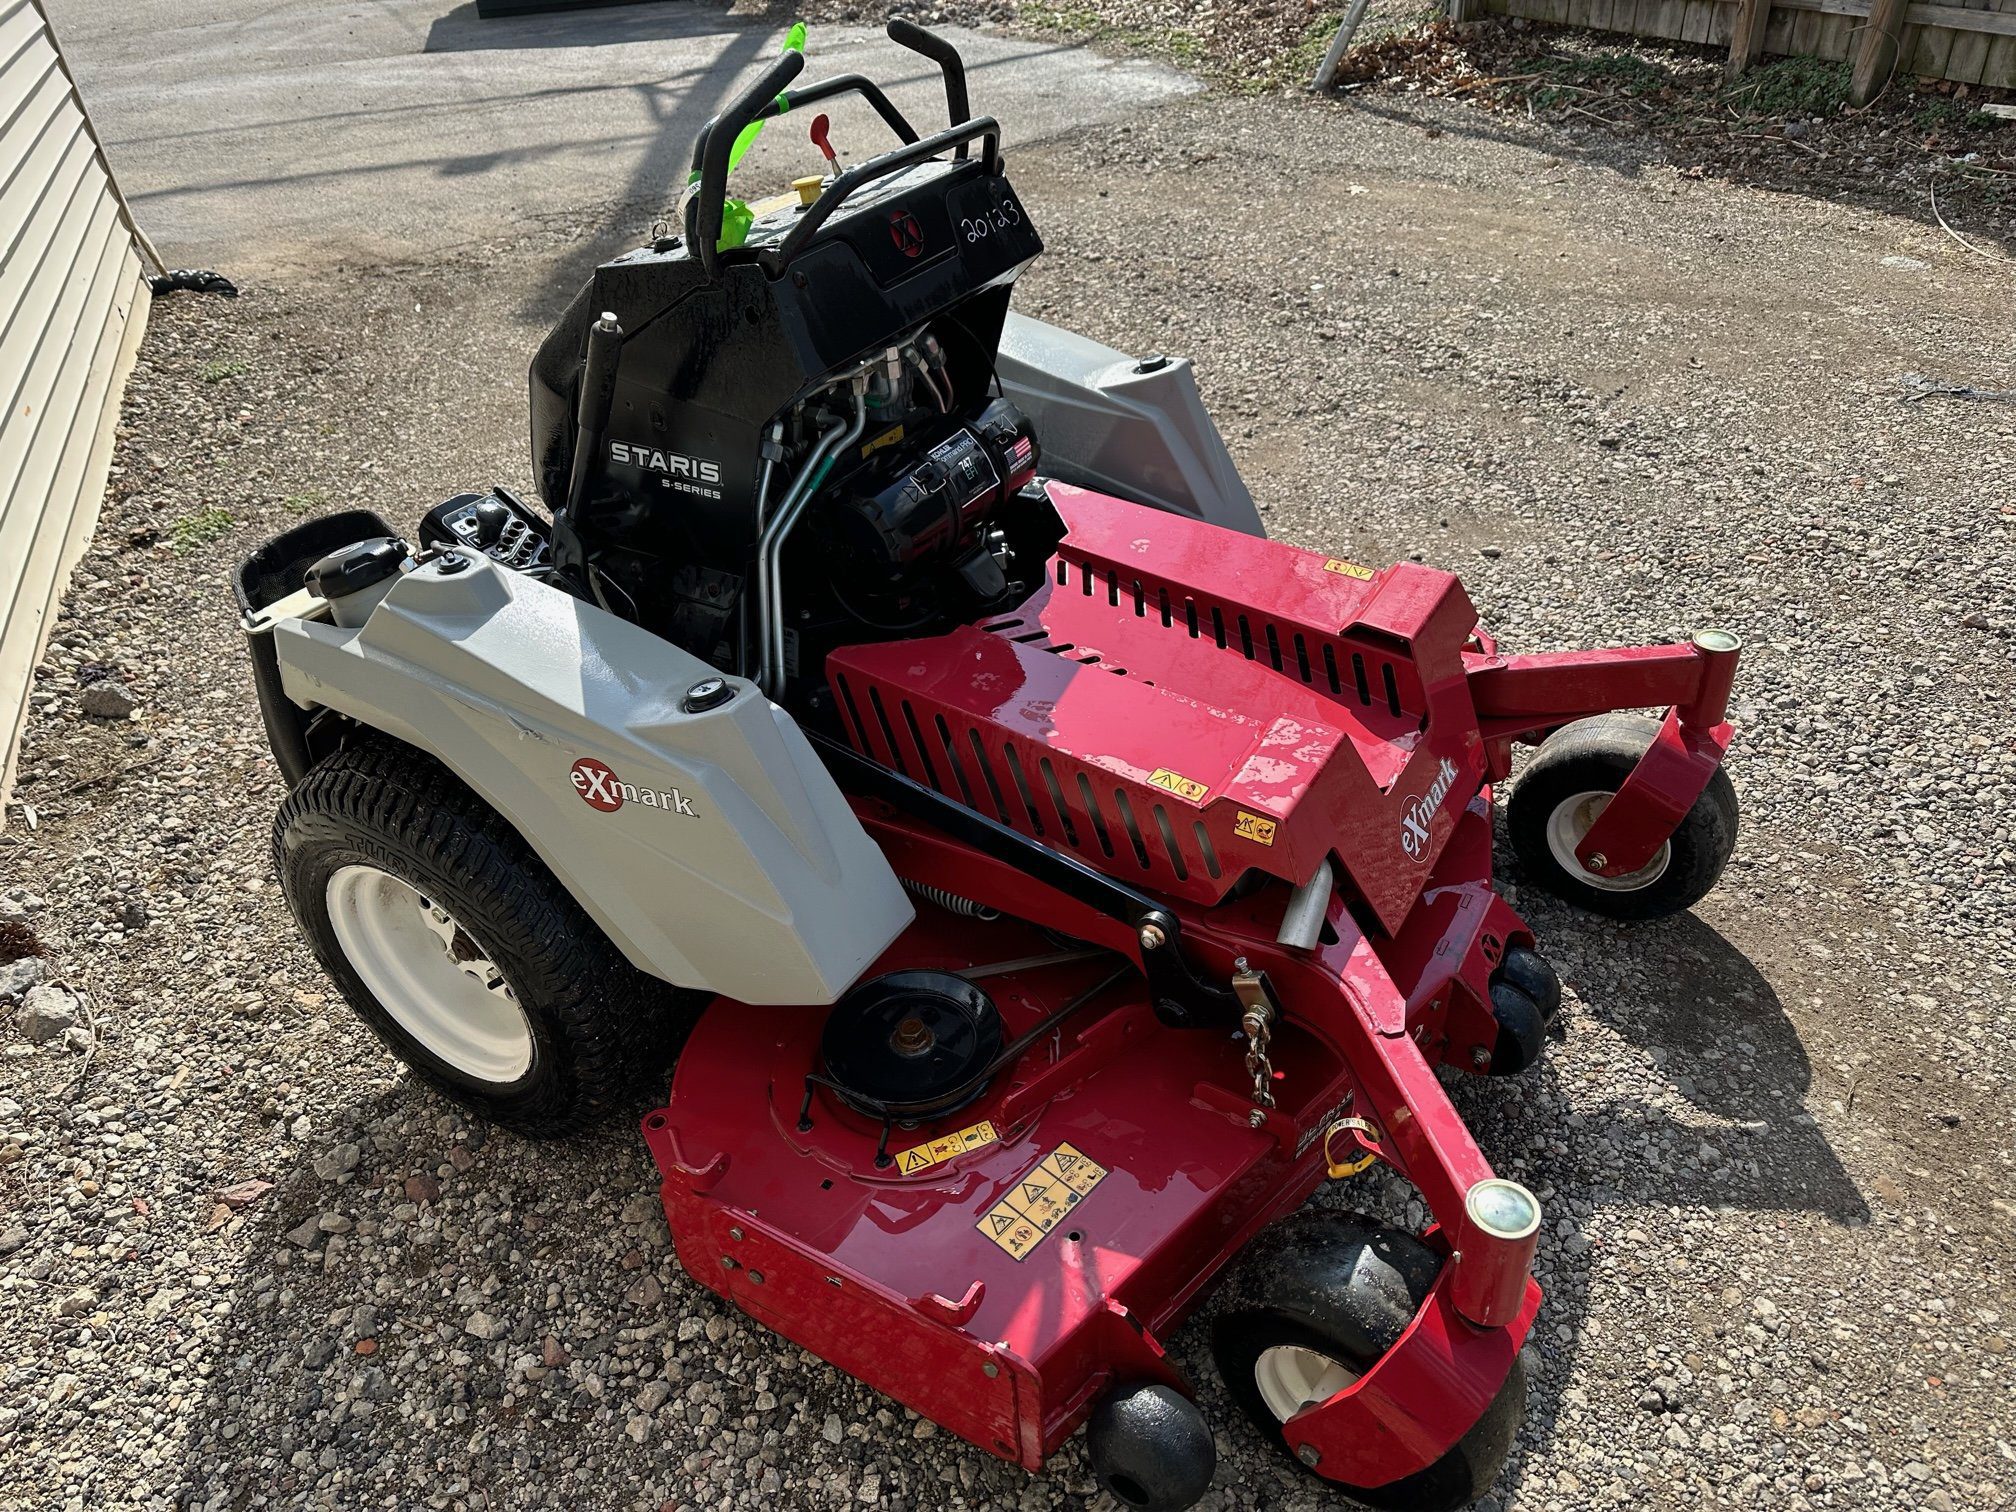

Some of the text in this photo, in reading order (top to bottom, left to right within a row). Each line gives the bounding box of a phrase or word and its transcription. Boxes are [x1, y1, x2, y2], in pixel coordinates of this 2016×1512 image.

[930, 444, 952, 461] KOHLER
[959, 438, 974, 450] PRO
[611, 442, 720, 483] STARIS
[958, 456, 973, 471] 747
[965, 466, 979, 480] EFI
[662, 478, 721, 499] S-SERIES
[570, 765, 696, 818] eXmark
[1401, 757, 1459, 857] eXmark
[345, 833, 431, 885] TURF
